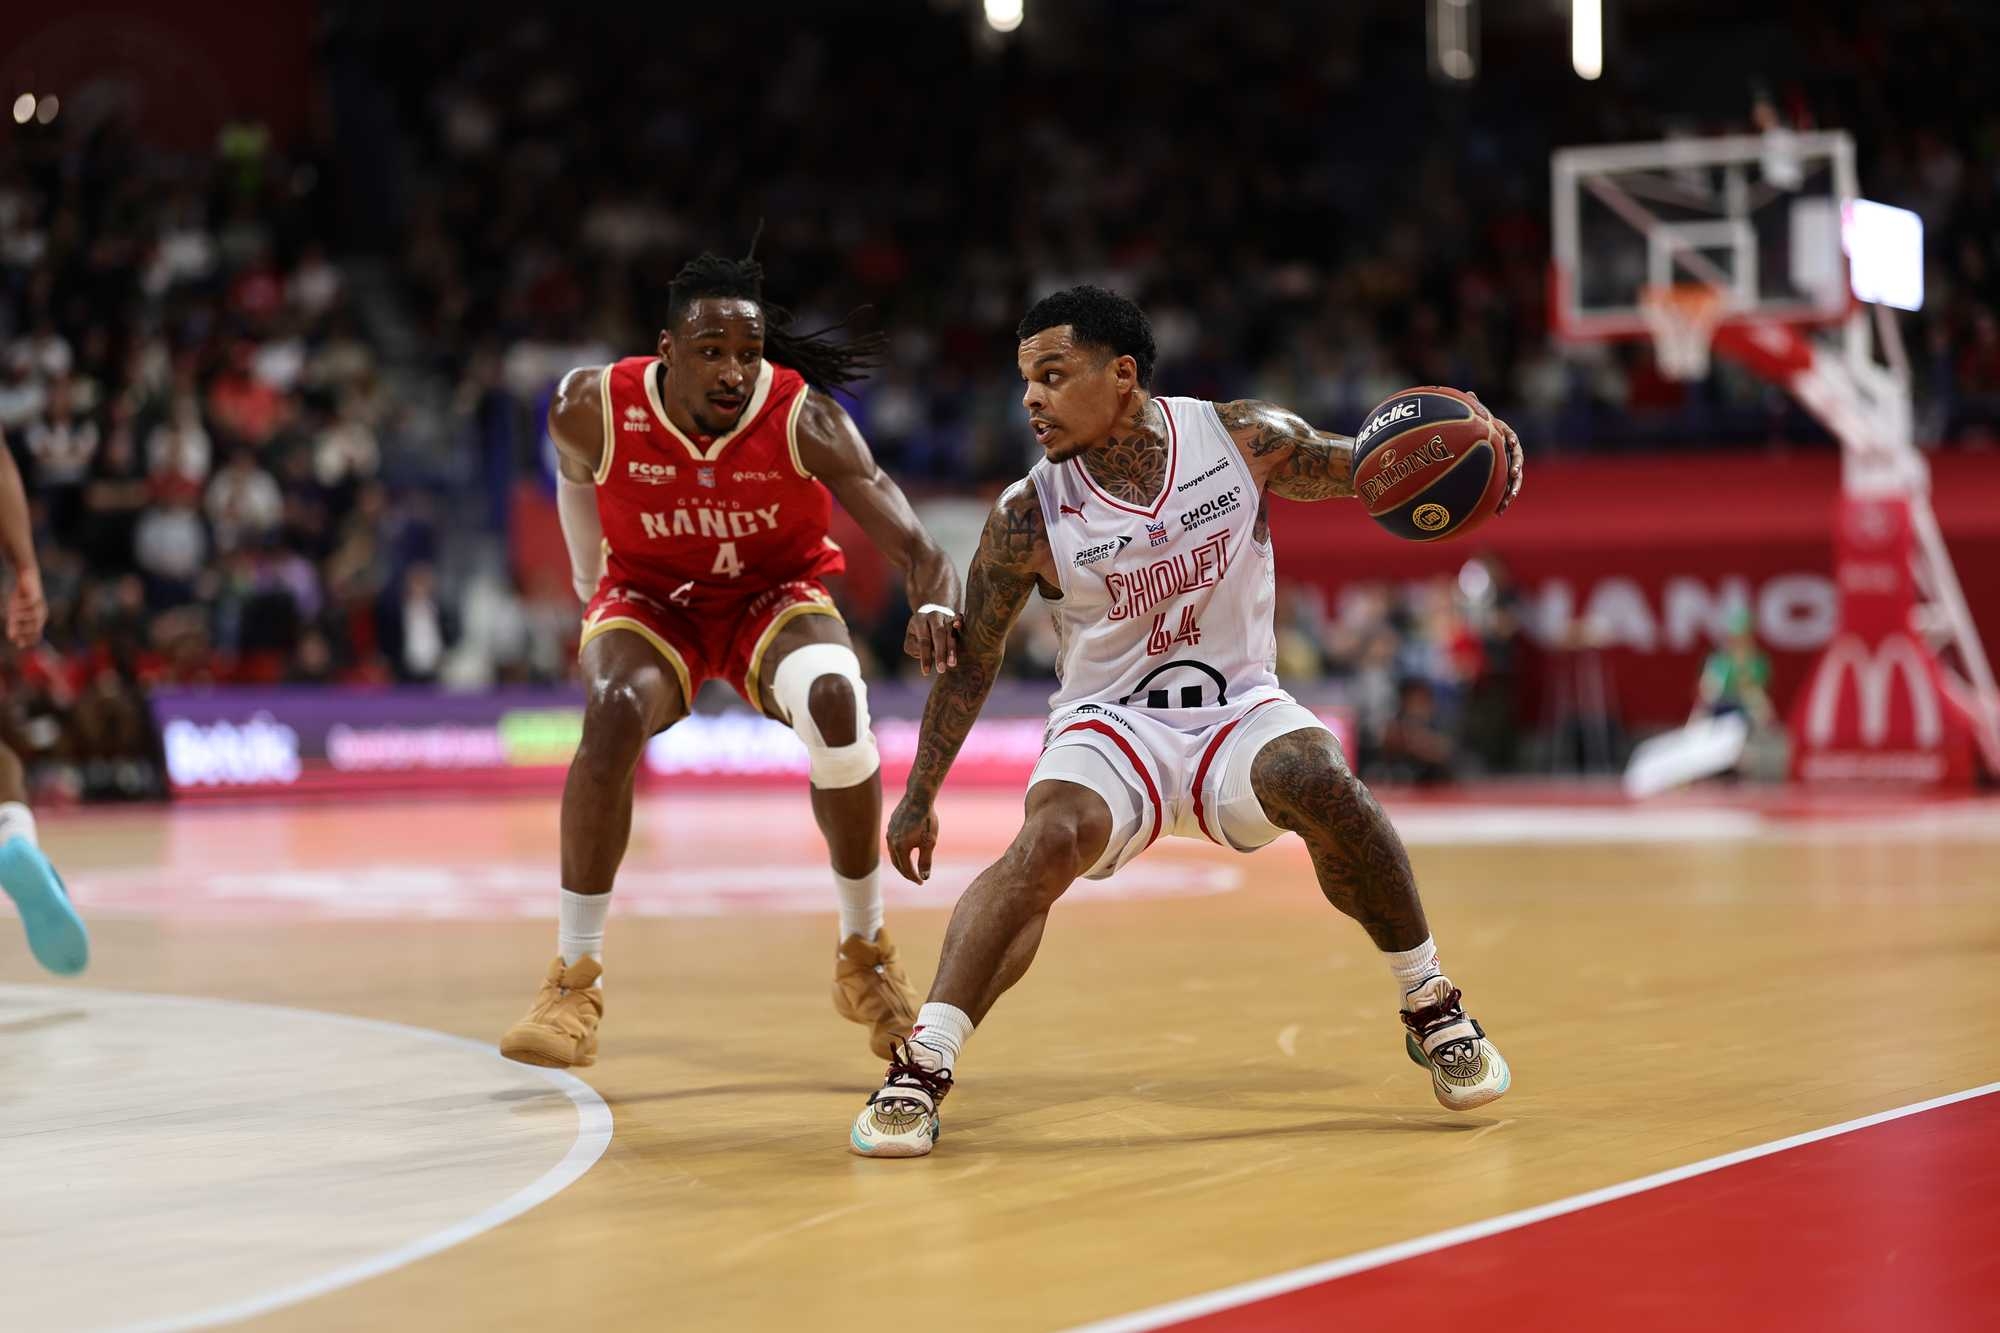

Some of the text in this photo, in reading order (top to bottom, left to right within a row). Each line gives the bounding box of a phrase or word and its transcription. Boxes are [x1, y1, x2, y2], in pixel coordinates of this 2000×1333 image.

[1177, 460, 1230, 493] bouyer leroux
[640, 502, 780, 539] NANCY
[711, 541, 745, 579] 4
[1105, 528, 1231, 621] CHOLET
[1146, 604, 1202, 657] 44
